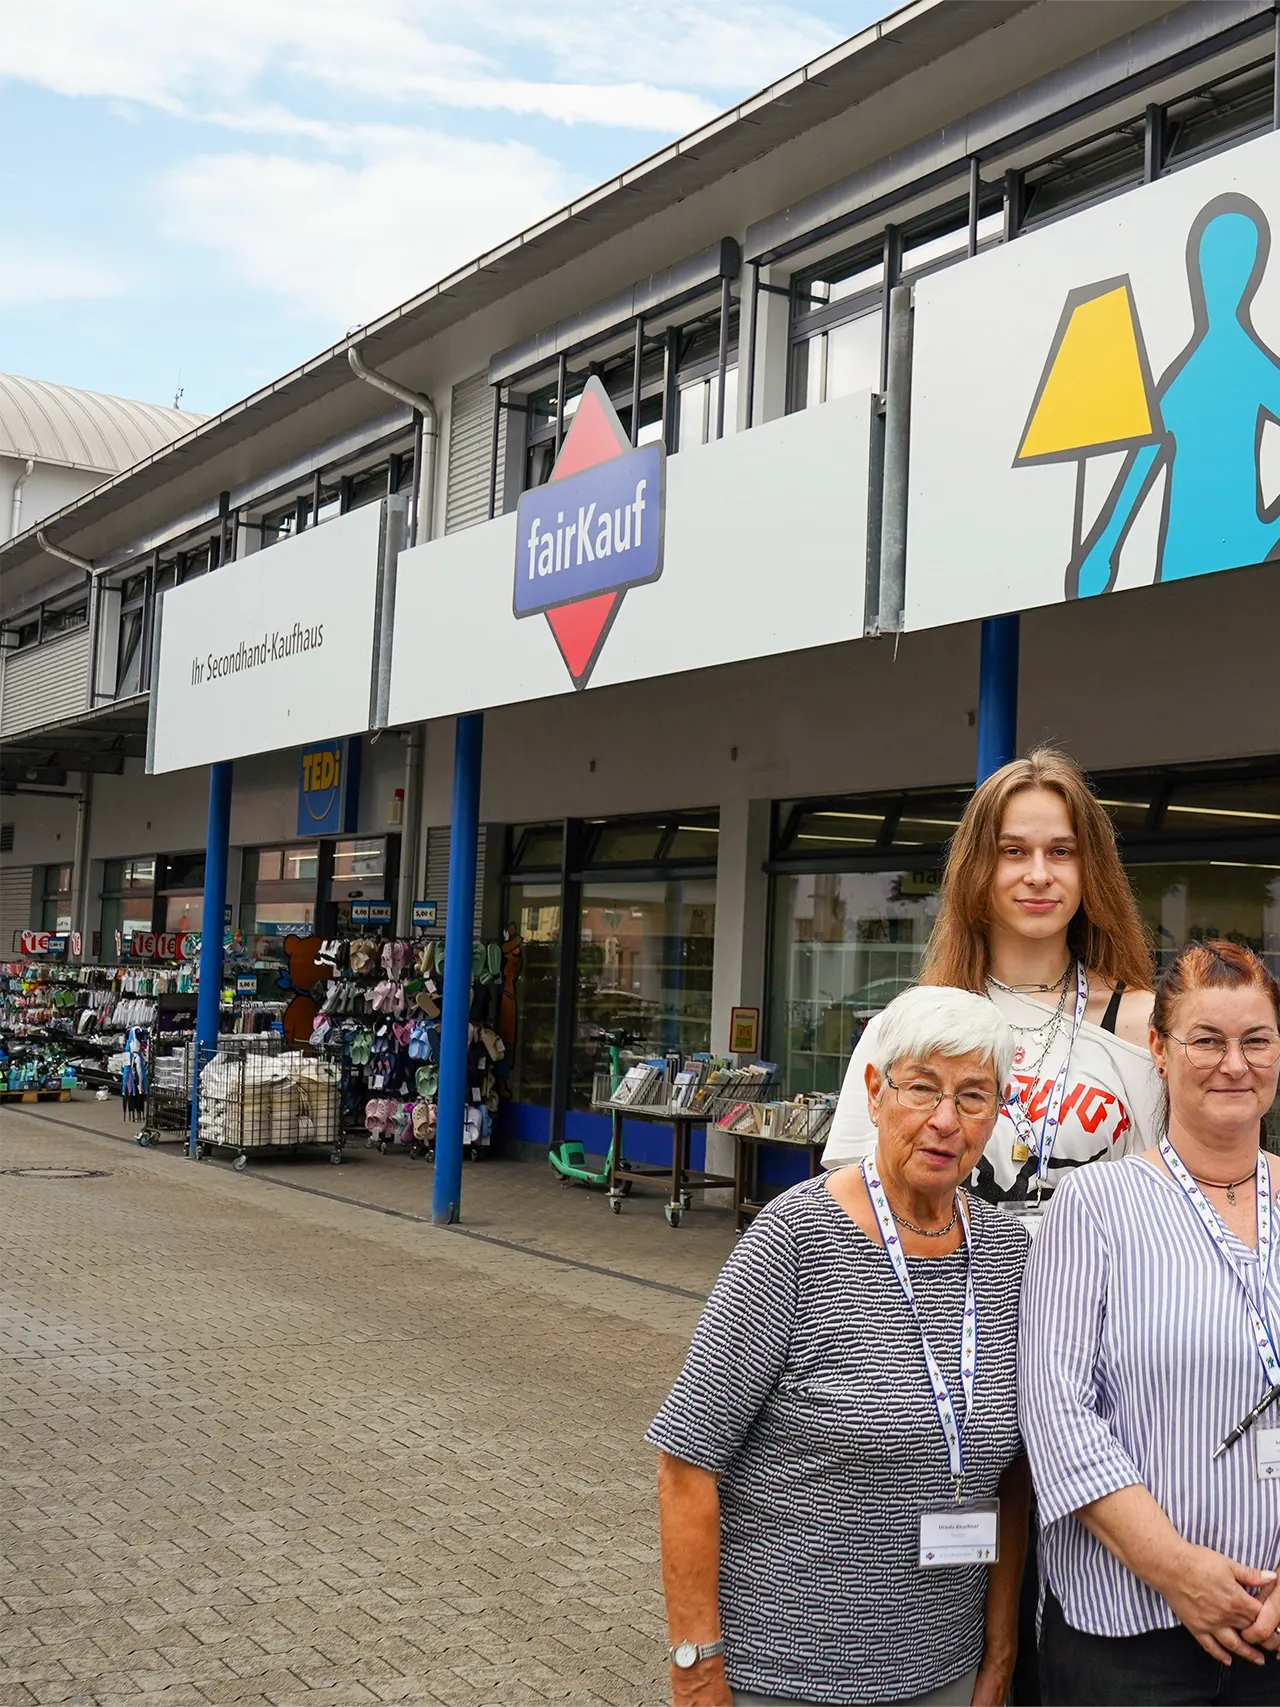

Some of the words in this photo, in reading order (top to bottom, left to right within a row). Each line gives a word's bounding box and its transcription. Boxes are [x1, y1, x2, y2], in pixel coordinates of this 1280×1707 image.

[528, 479, 647, 580] fairKauf
[191, 657, 204, 686] Ihr
[206, 621, 324, 682] Secondhand-Kaufhaus
[302, 748, 340, 793] TEDi
[139, 934, 154, 953] 1€
